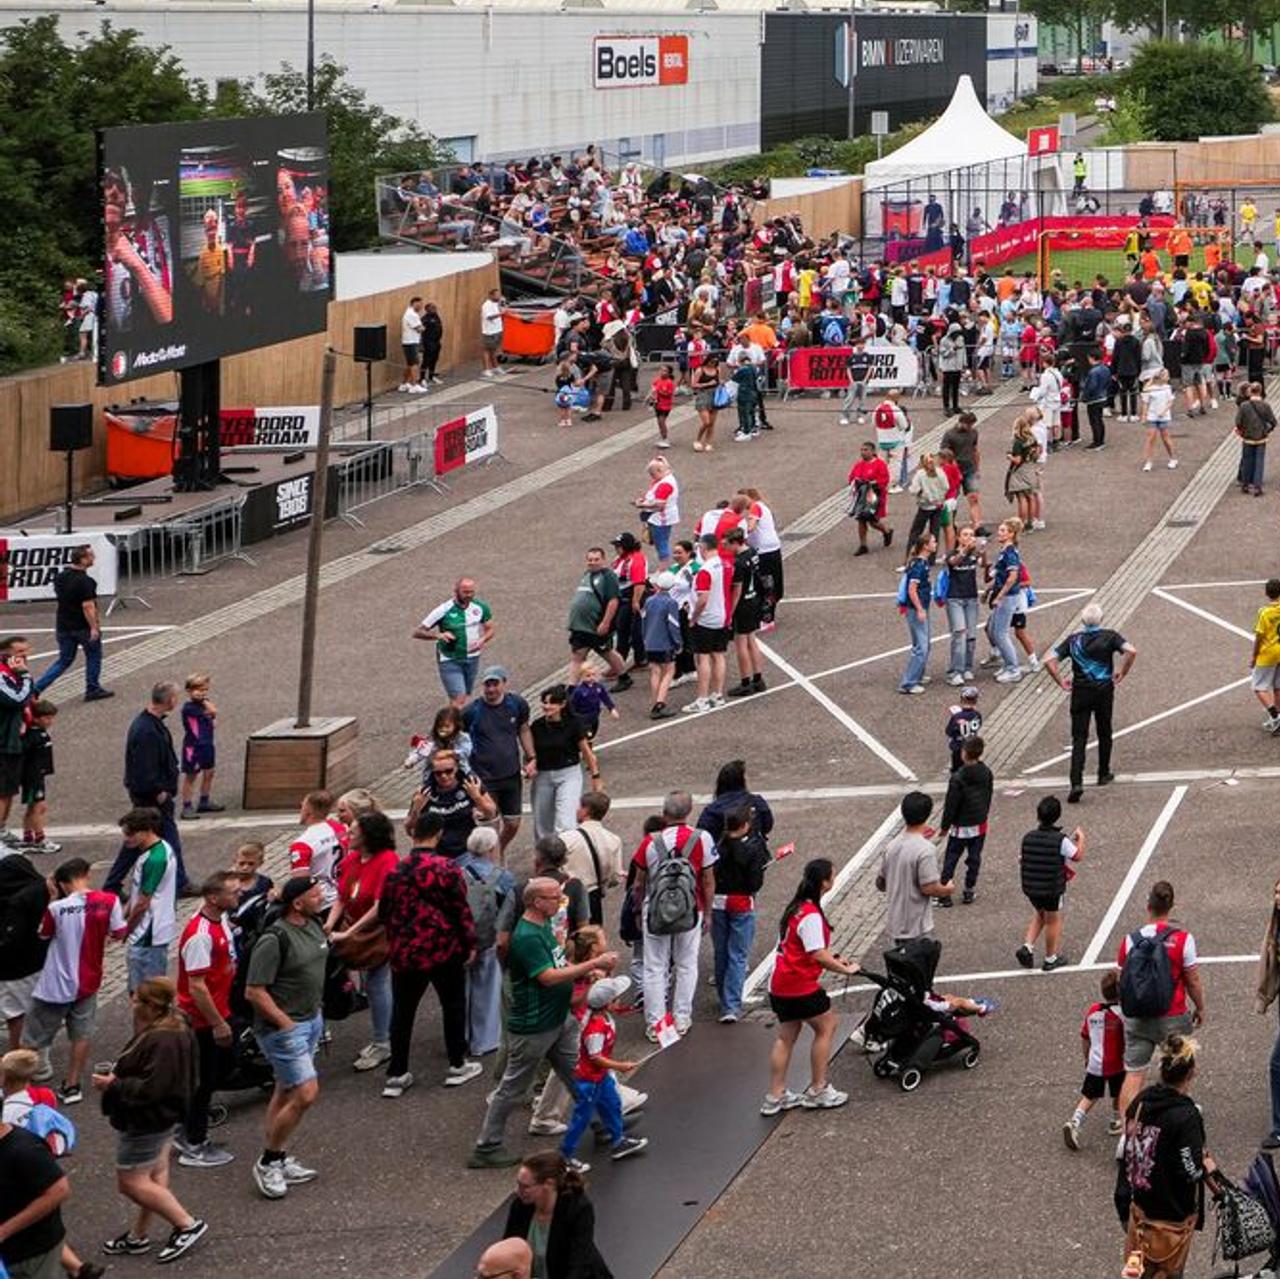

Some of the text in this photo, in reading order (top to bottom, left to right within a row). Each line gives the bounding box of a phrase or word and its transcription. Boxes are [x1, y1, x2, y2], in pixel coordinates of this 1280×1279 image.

[597, 45, 656, 79] Boels
[862, 40, 886, 67] BMN
[277, 476, 309, 503] SINCE
[279, 493, 308, 520] 1908
